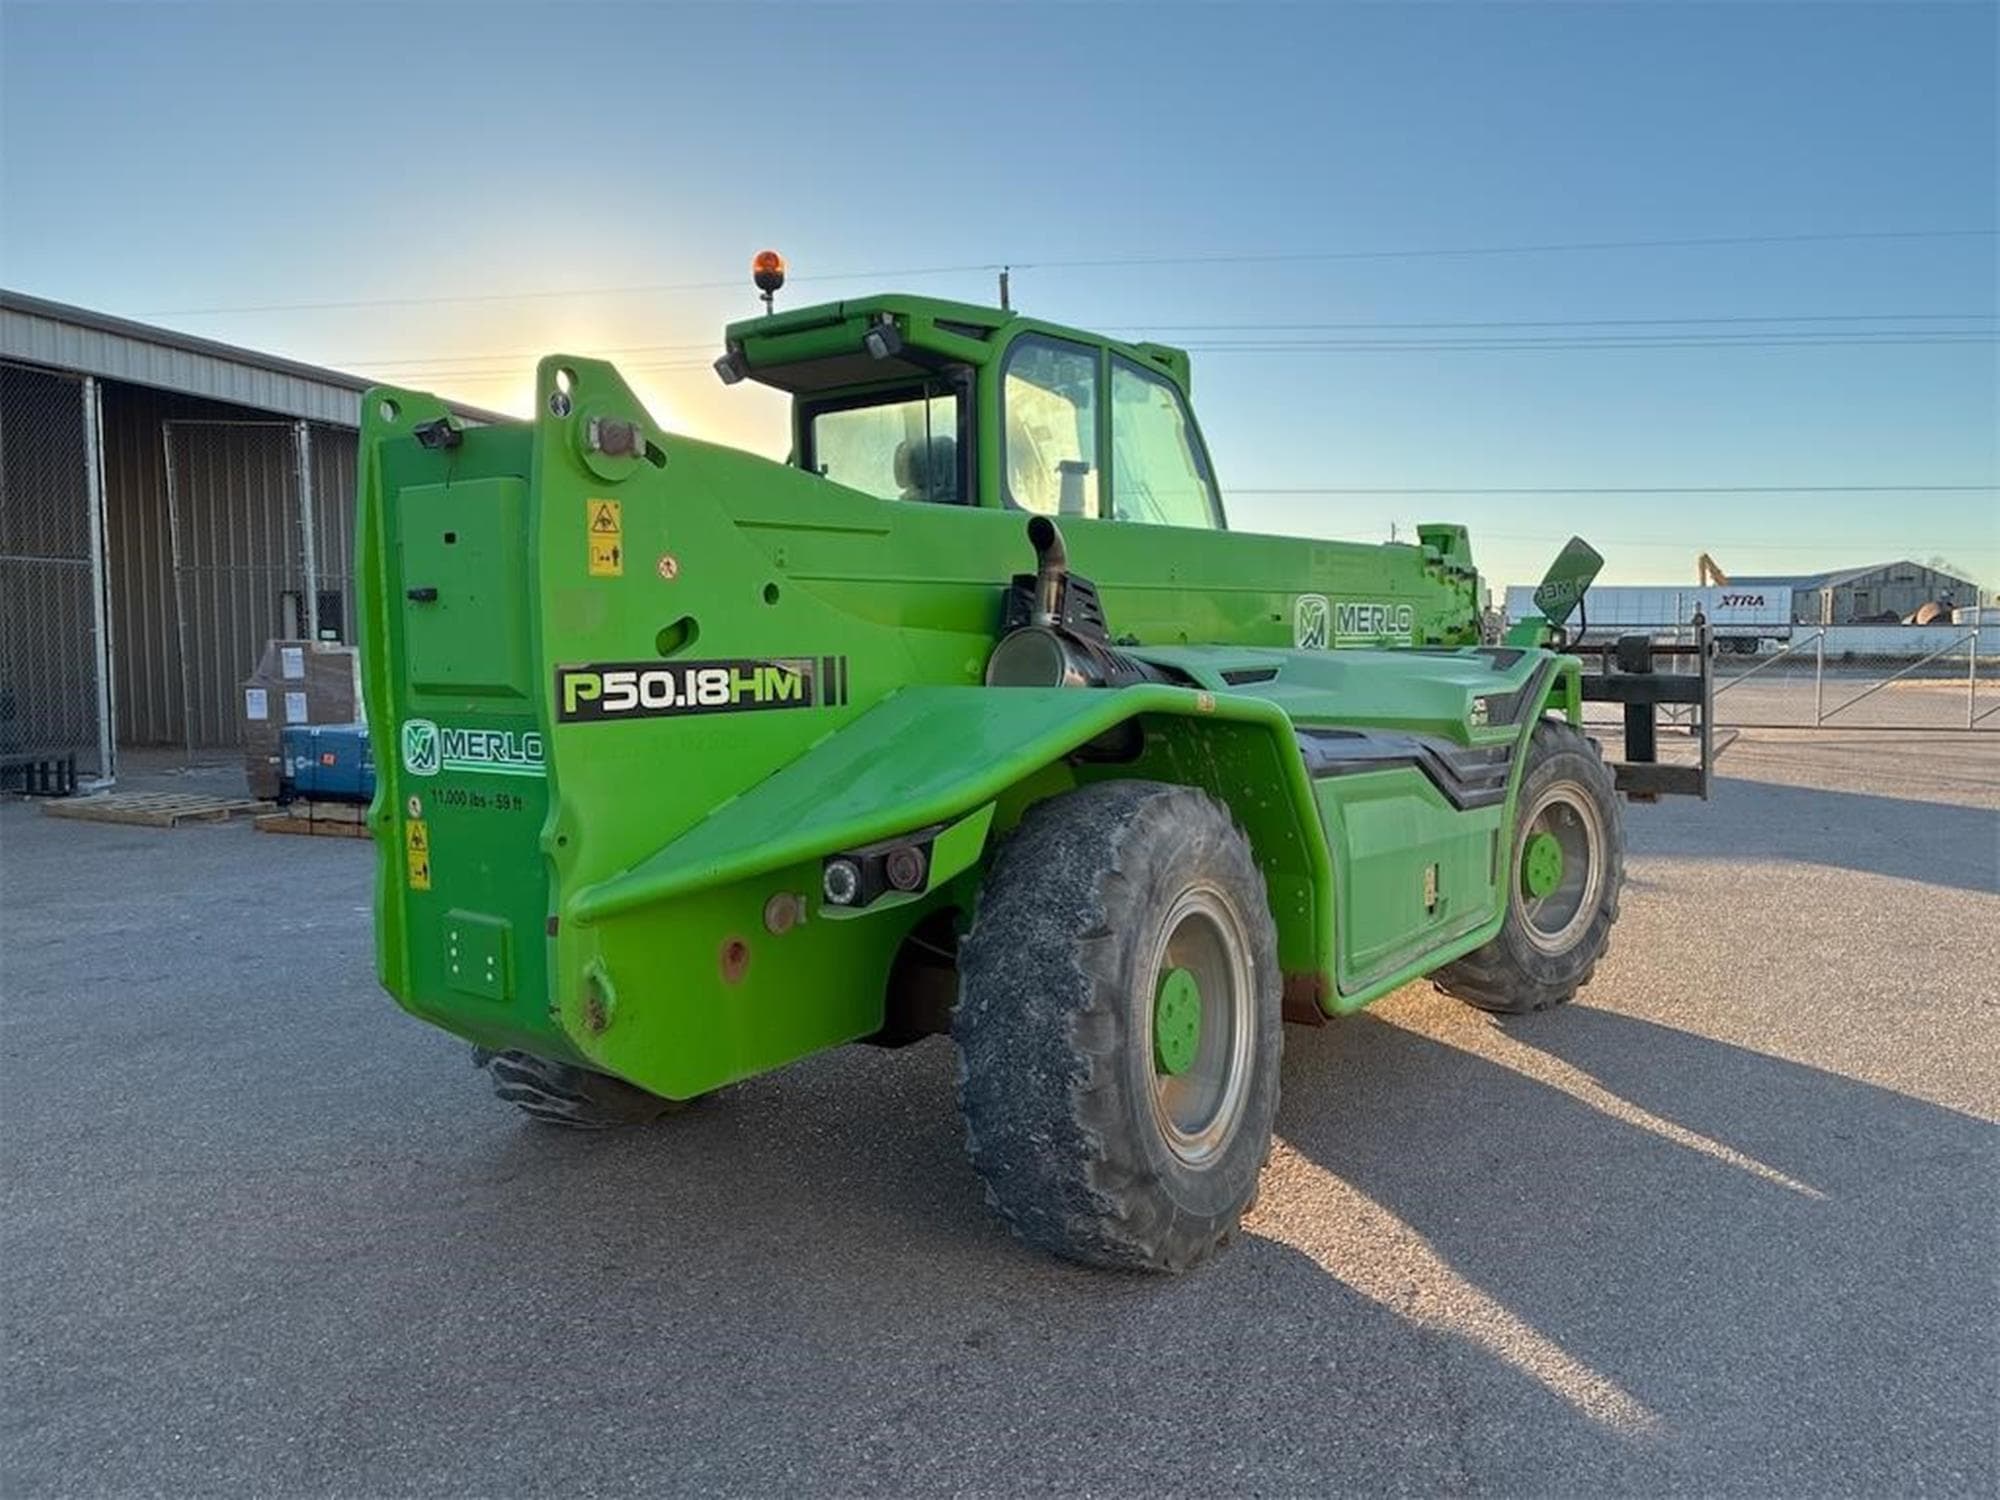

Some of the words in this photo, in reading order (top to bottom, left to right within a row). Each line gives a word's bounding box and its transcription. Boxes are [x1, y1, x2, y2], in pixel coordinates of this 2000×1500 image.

[1718, 594, 1765, 608] XTRA
[1335, 604, 1412, 634] MERLO
[563, 667, 802, 713] P50.18HM
[441, 729, 545, 763] MERLO
[469, 790, 486, 808] lbs
